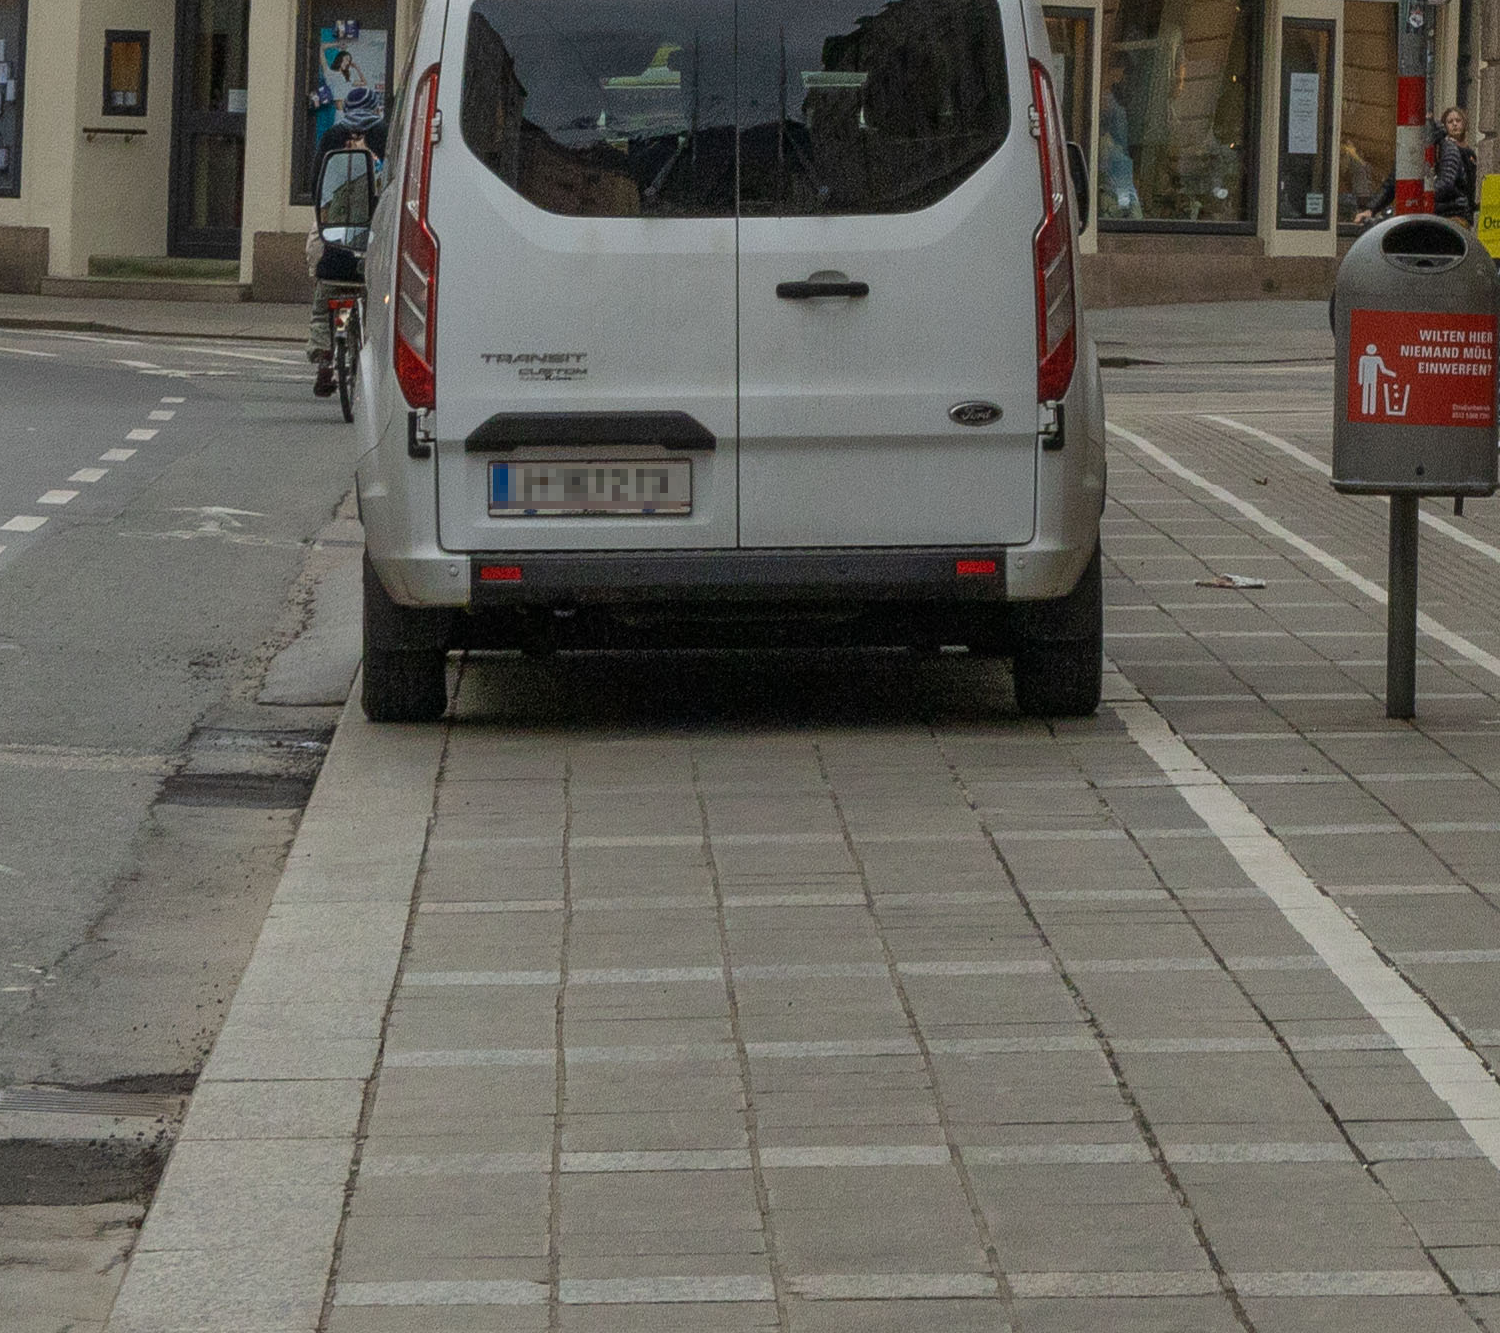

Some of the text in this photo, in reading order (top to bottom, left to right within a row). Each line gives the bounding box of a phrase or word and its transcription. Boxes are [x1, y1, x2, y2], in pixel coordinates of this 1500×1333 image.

[1419, 330, 1493, 344] WILTEN HIER
[481, 353, 588, 365] TRANSIT
[1400, 345, 1493, 360] NIEMAND MÜLL
[518, 368, 588, 376] CUSTOM
[1418, 361, 1492, 376] EINWERFEN?
[961, 406, 992, 421] Ford
